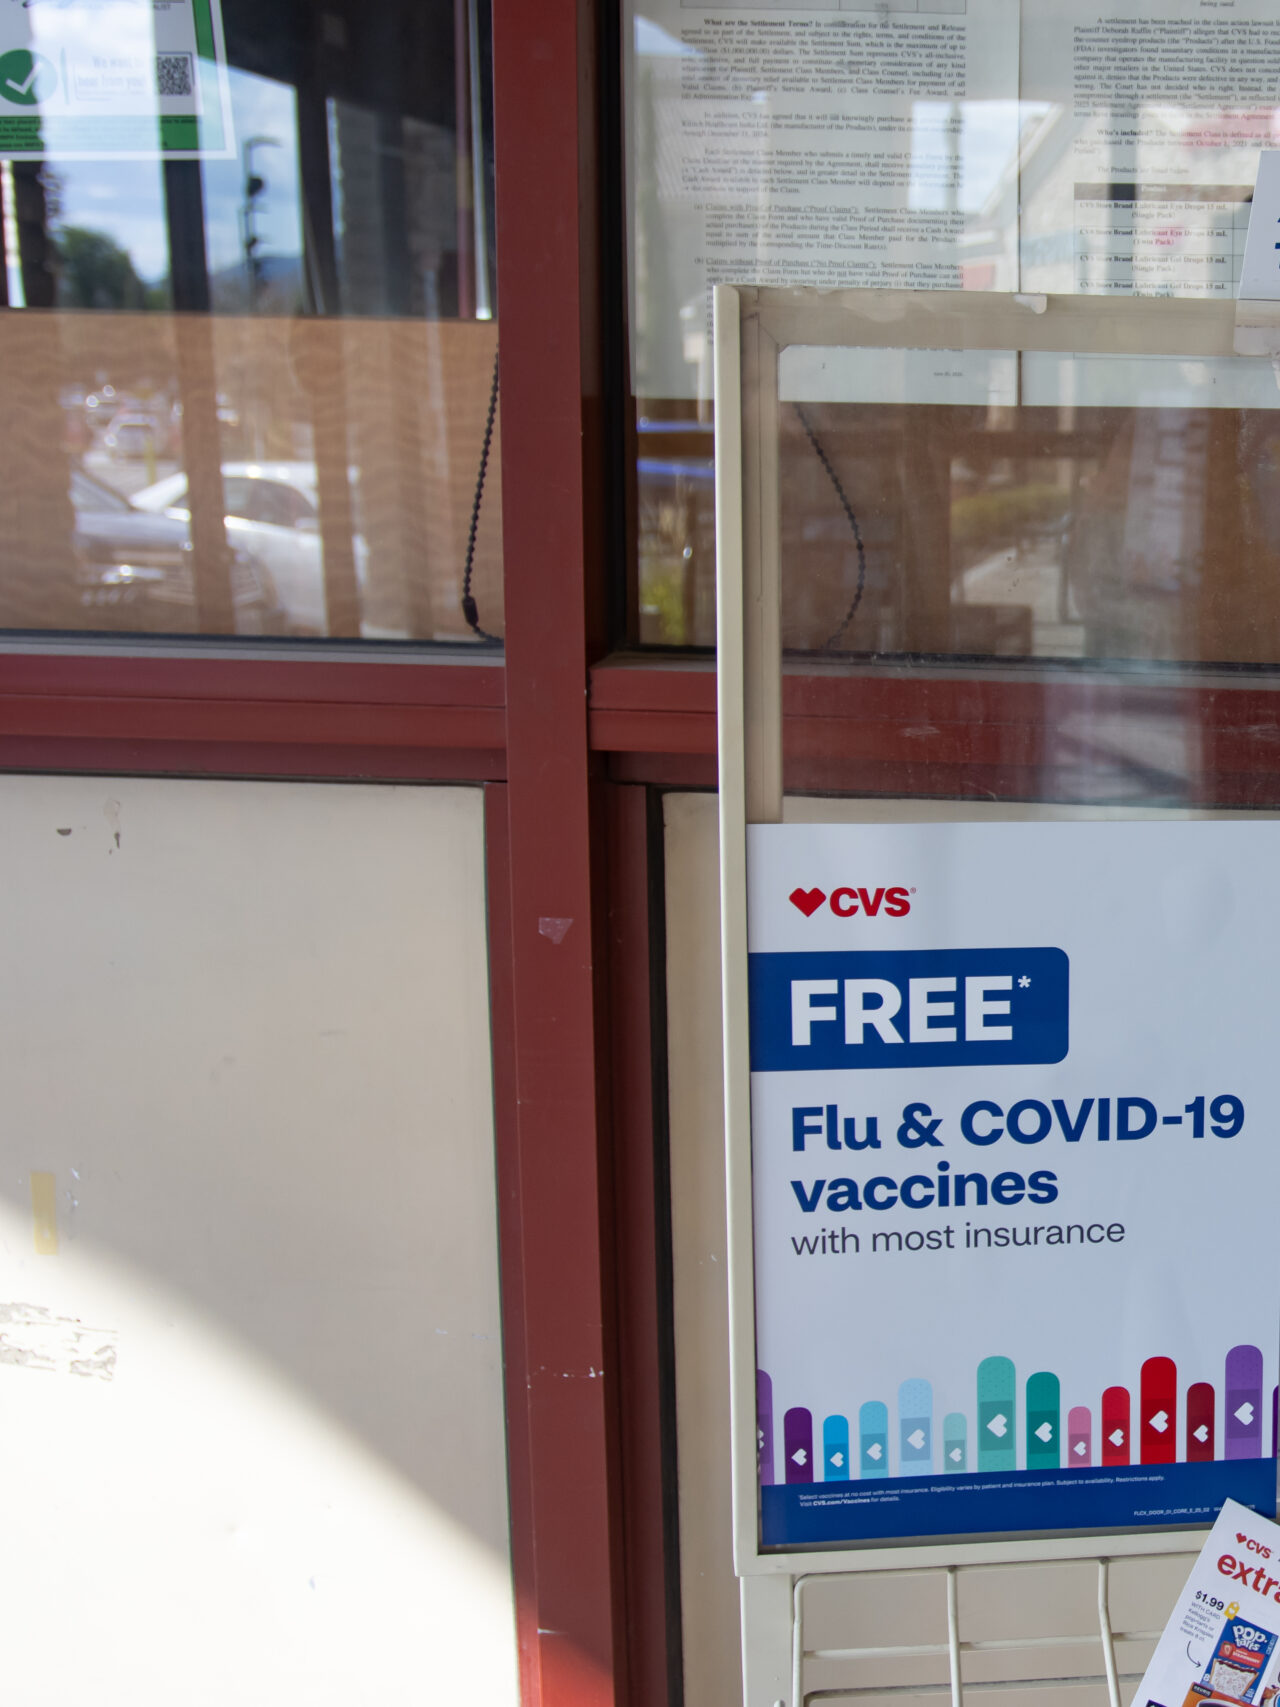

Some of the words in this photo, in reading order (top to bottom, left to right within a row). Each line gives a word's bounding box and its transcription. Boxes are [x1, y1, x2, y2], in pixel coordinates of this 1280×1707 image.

[892, 22, 925, 30] Settlement
[791, 1103, 882, 1152] Flu
[896, 1102, 945, 1149] &
[960, 1094, 1245, 1147] COVID-19
[789, 1160, 1059, 1213] vaccines
[791, 1227, 860, 1256] with
[871, 1223, 955, 1253] most
[964, 1221, 1126, 1249] insurance
[930, 1485, 955, 1493] Eligibility
[1056, 1479, 1078, 1487] Subject
[813, 1497, 870, 1506] CVS.com/Vaccines
[1246, 1539, 1272, 1559] CVS
[1195, 1590, 1225, 1611] $1.99
